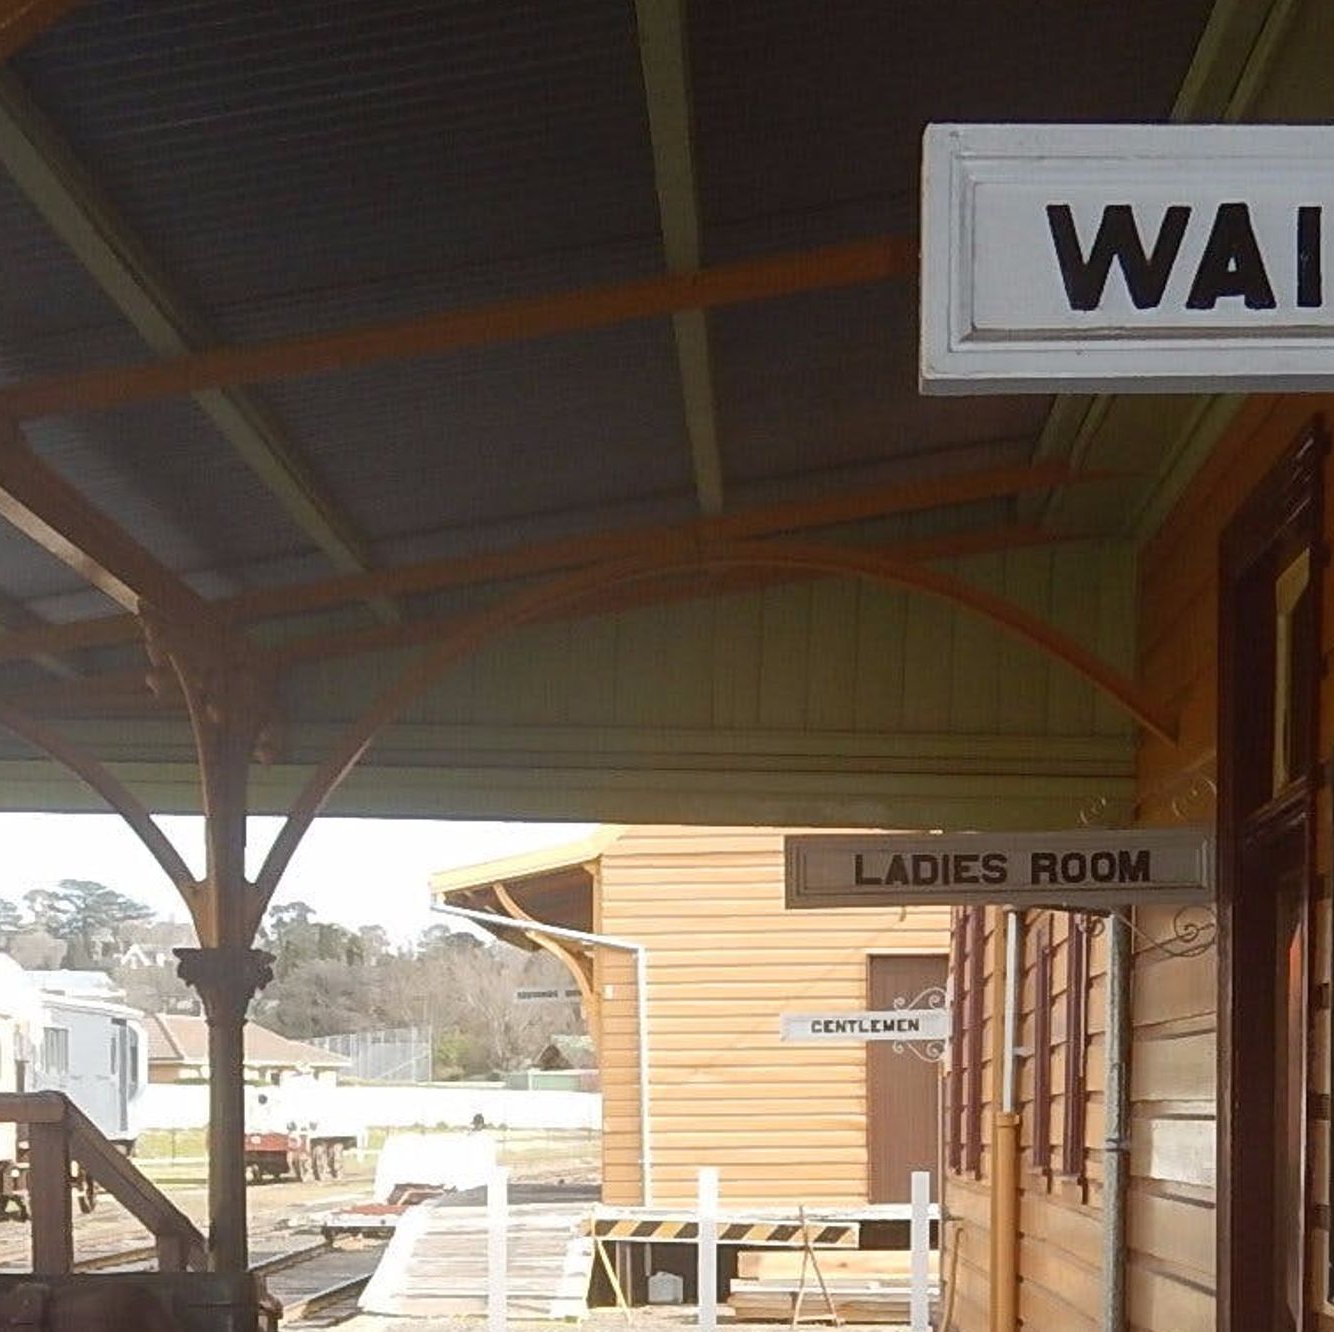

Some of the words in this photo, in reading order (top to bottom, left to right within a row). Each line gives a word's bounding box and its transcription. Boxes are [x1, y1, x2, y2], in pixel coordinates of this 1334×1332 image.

[854, 853, 1008, 885] LADIES
[1030, 850, 1151, 884] ROOM
[810, 1018, 920, 1033] GENTLEMEN
